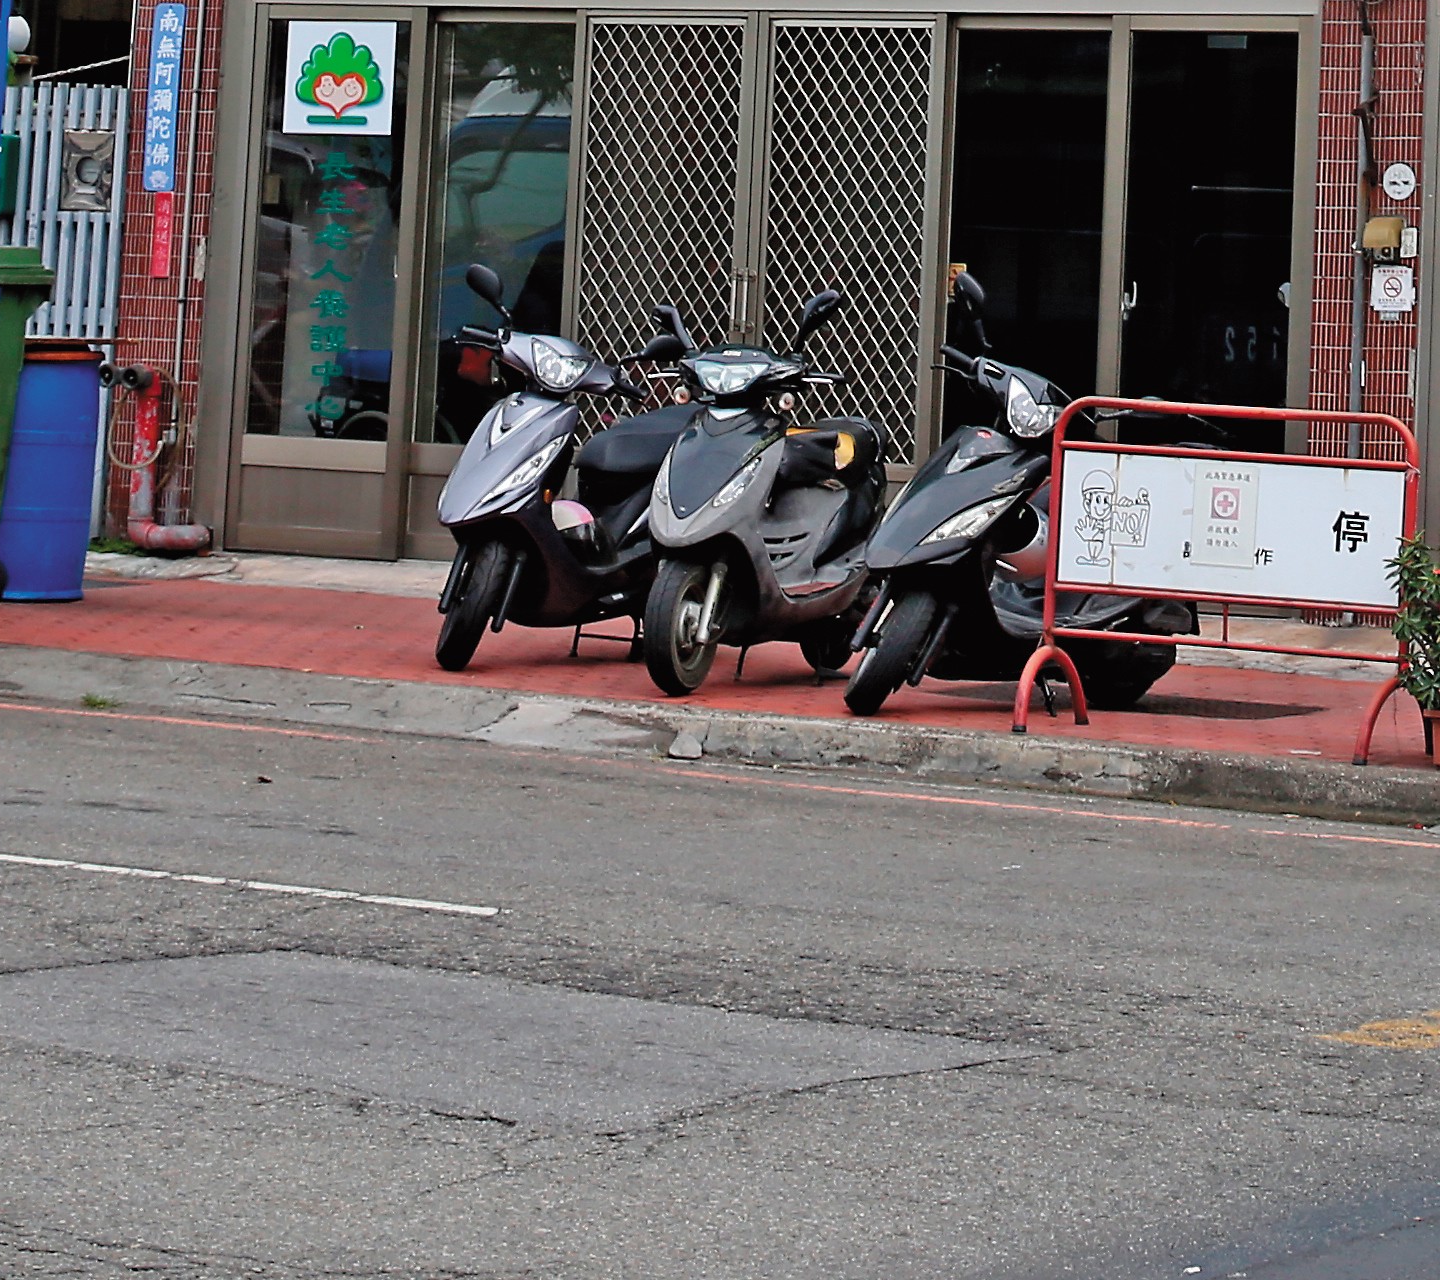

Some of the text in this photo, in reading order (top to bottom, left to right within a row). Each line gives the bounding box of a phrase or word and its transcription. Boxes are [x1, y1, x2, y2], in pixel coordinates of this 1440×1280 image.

[150, 8, 179, 168] 南無阿彌陀佛
[1331, 509, 1371, 553] 停
